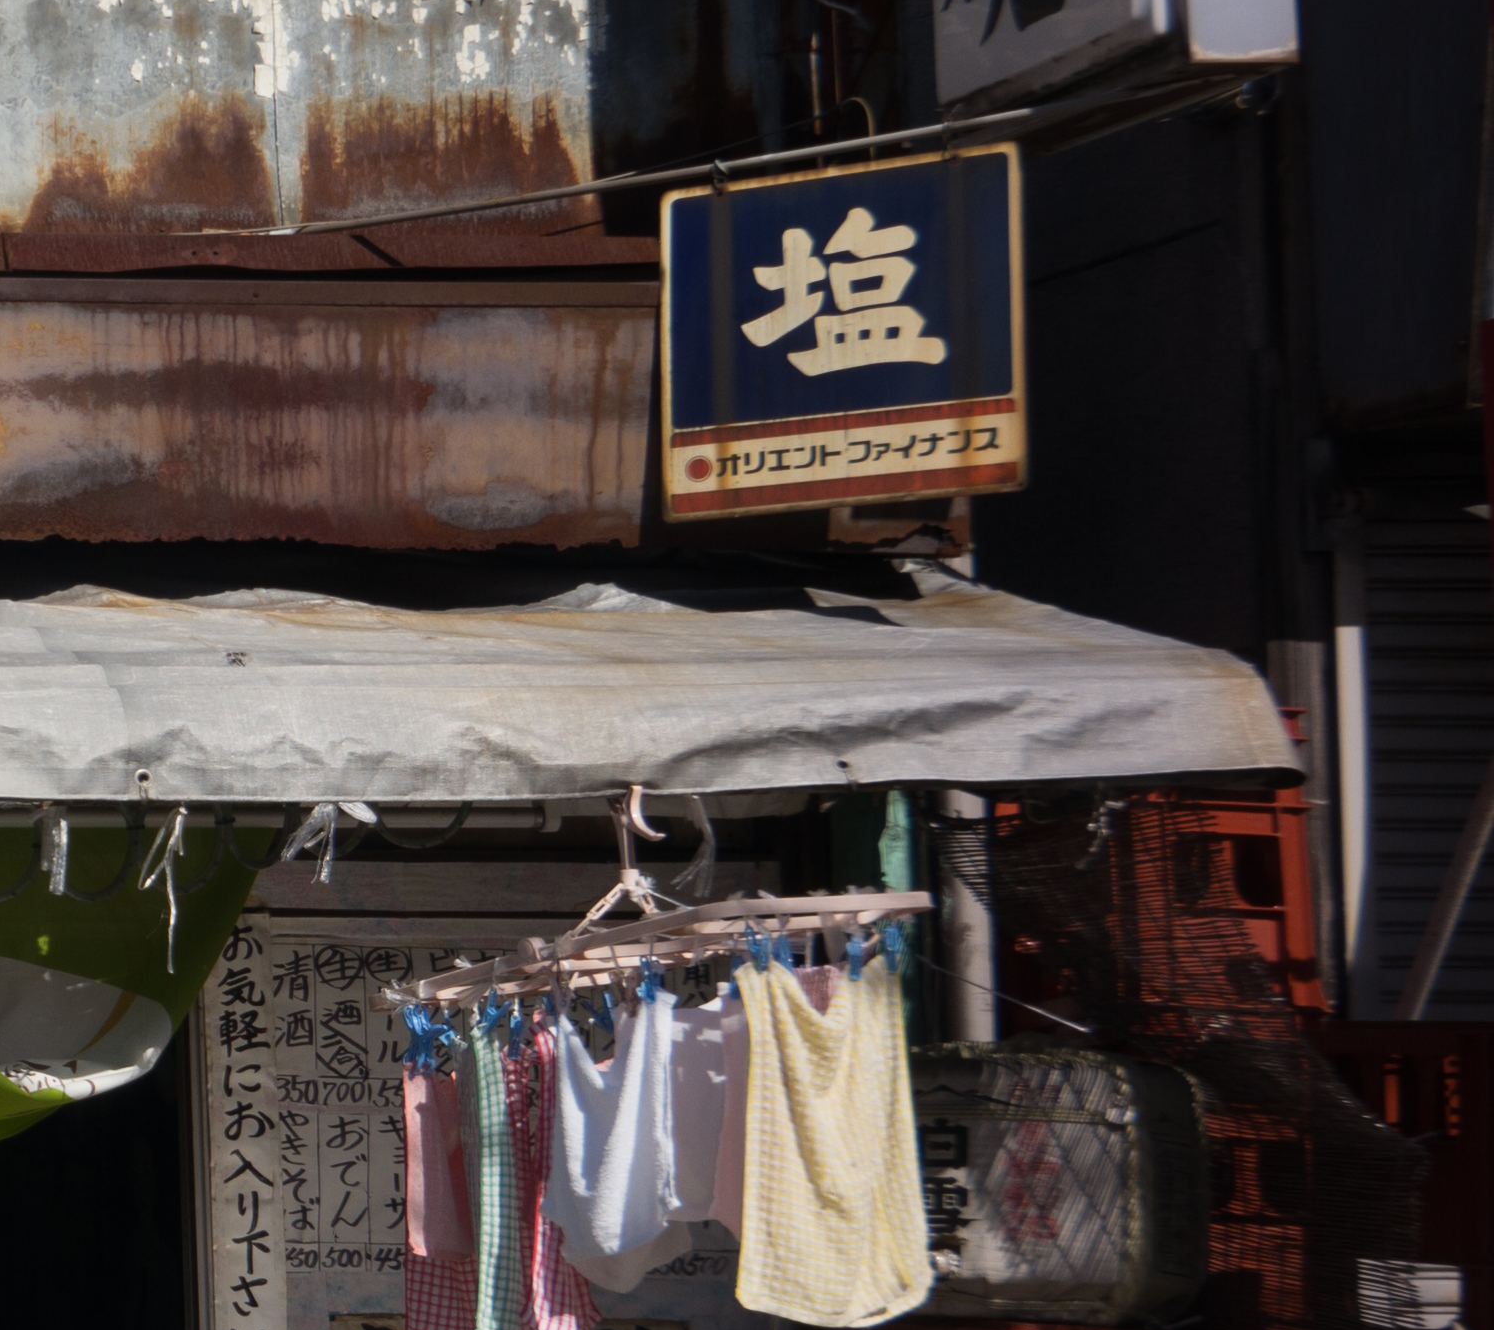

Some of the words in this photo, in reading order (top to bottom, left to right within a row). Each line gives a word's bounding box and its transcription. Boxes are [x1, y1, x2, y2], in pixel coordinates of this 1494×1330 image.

[741, 207, 947, 377] 塩
[716, 427, 1000, 478] オリエントファイナンス
[272, 949, 315, 1047] 清酒
[276, 1077, 318, 1105] 350
[323, 1079, 365, 1105] 700
[279, 1112, 319, 1230] やきそば
[326, 1118, 368, 1228] おでん
[323, 1249, 361, 1270] 500
